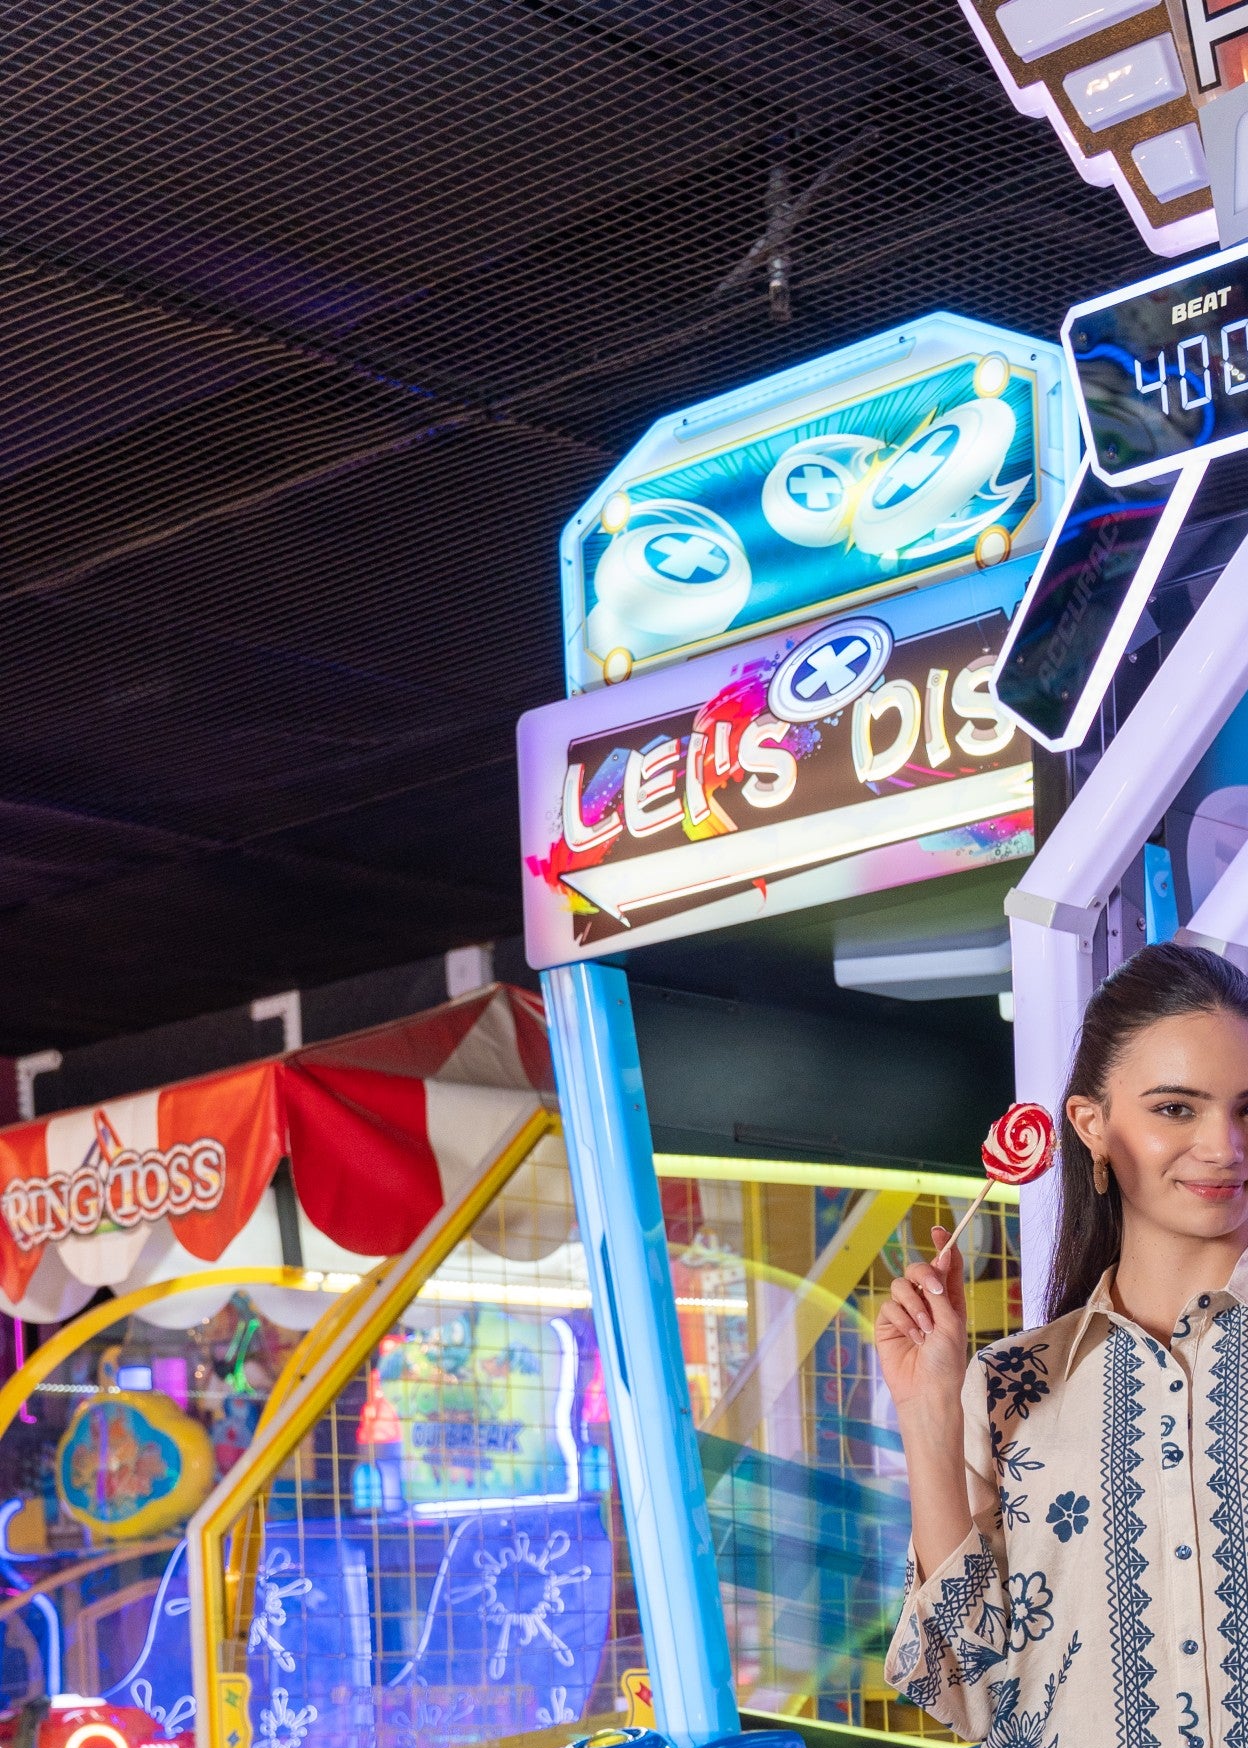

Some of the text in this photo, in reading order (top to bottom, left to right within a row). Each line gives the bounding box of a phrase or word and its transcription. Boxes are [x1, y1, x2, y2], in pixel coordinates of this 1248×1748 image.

[1171, 285, 1232, 325] BEAT
[850, 654, 1016, 784] DIS
[3, 1147, 222, 1244] RING TOSS
